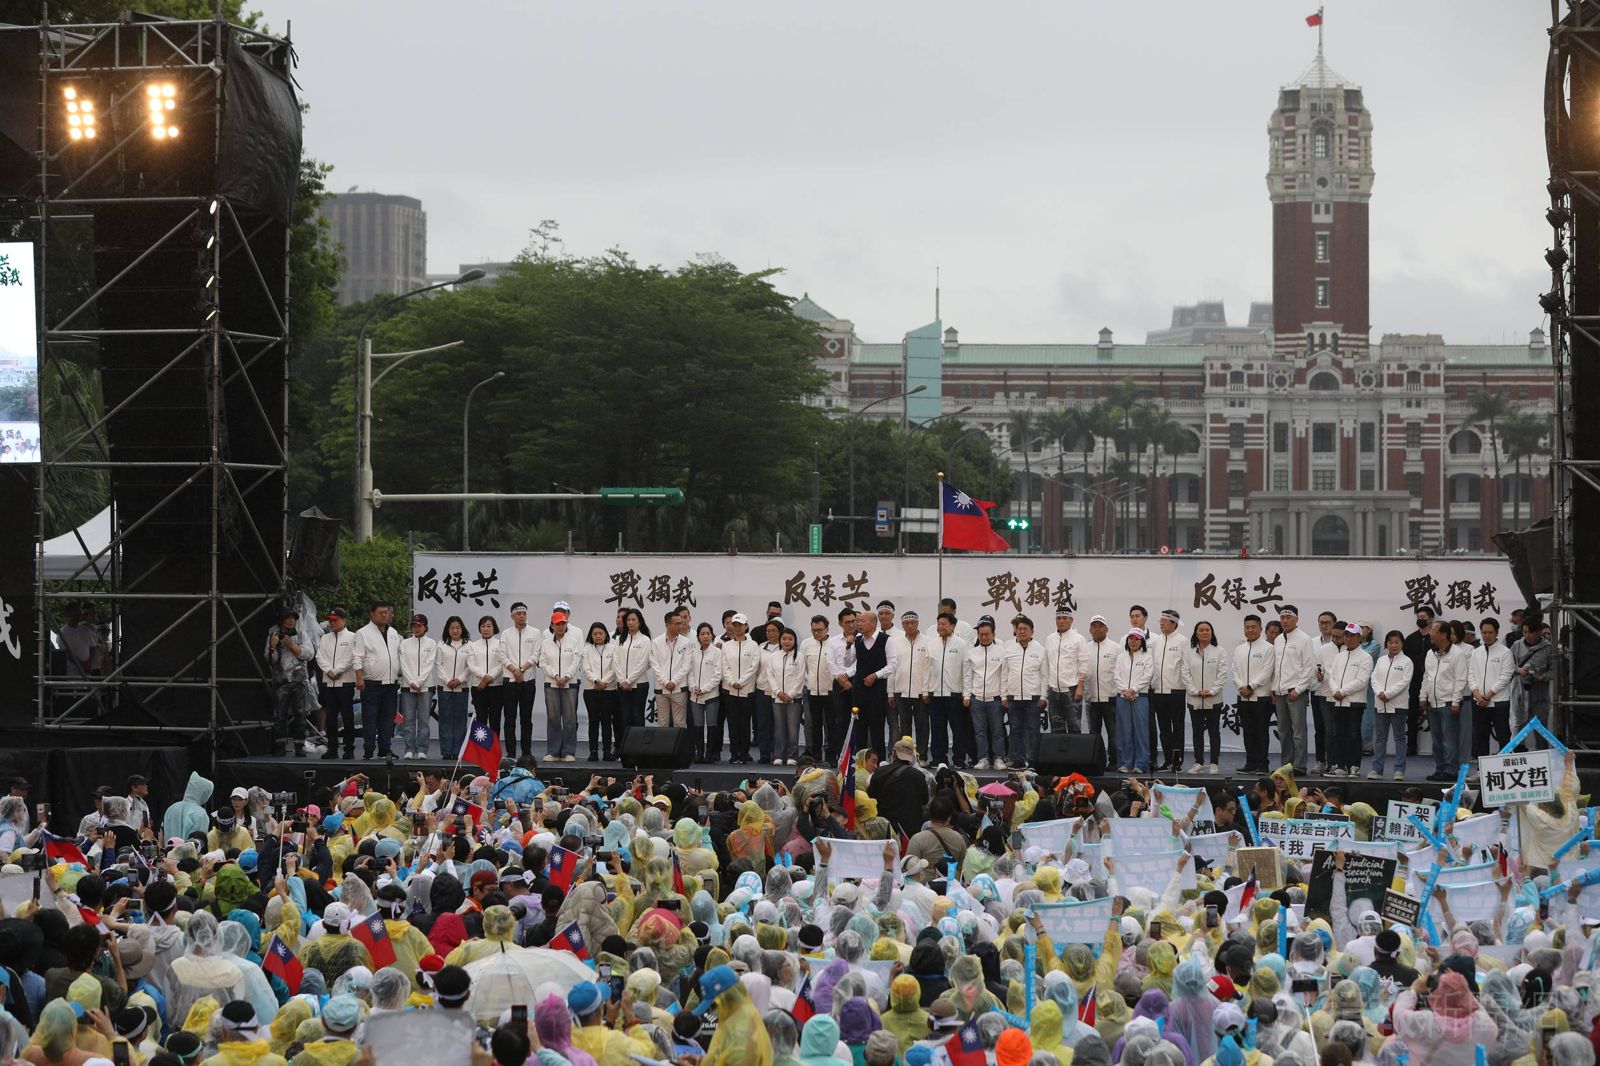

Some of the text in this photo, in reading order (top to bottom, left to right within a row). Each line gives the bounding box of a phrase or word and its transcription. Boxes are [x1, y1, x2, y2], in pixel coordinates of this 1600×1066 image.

[417, 567, 501, 609] 反綠共
[604, 568, 697, 610] 戰獨裁
[784, 570, 871, 610] 反綠共
[981, 571, 1078, 612] 戰獨裁
[1193, 572, 1287, 612] 反綠共
[1400, 574, 1501, 615] 戰獨裁
[1485, 766, 1548, 792] 柯文哲
[1503, 757, 1528, 767] 還給我
[1389, 822, 1429, 839] 賴清
